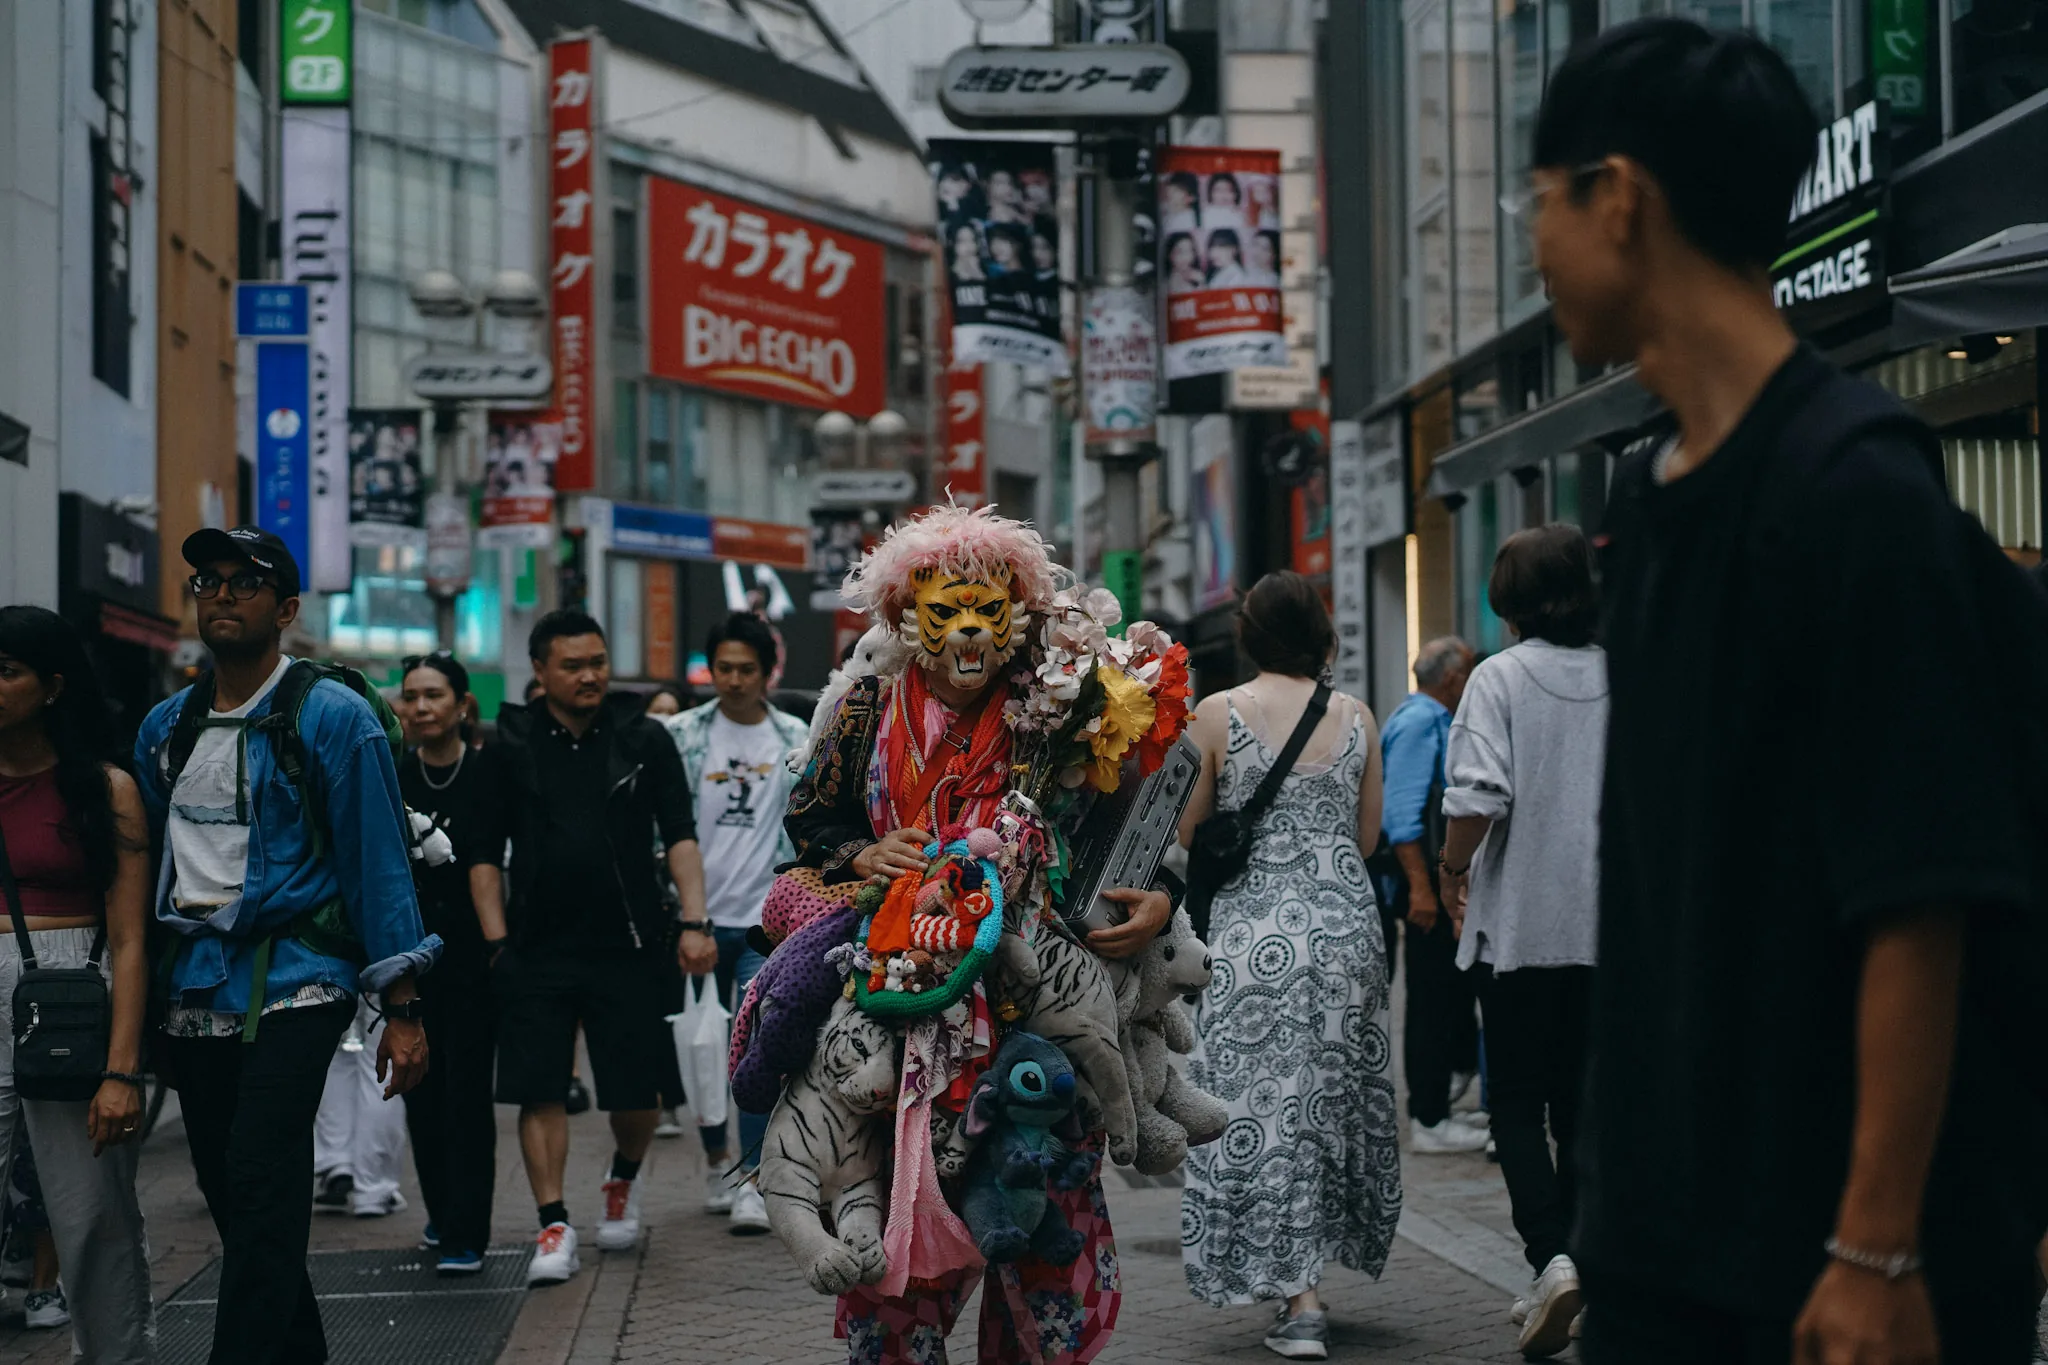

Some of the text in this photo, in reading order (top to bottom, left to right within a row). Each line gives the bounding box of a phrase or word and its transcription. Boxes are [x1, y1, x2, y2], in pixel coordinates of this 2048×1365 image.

[295, 0, 336, 44] ク
[554, 69, 592, 290] カラオケ
[683, 199, 857, 300] カラオケ
[1794, 238, 1872, 301] STAGE
